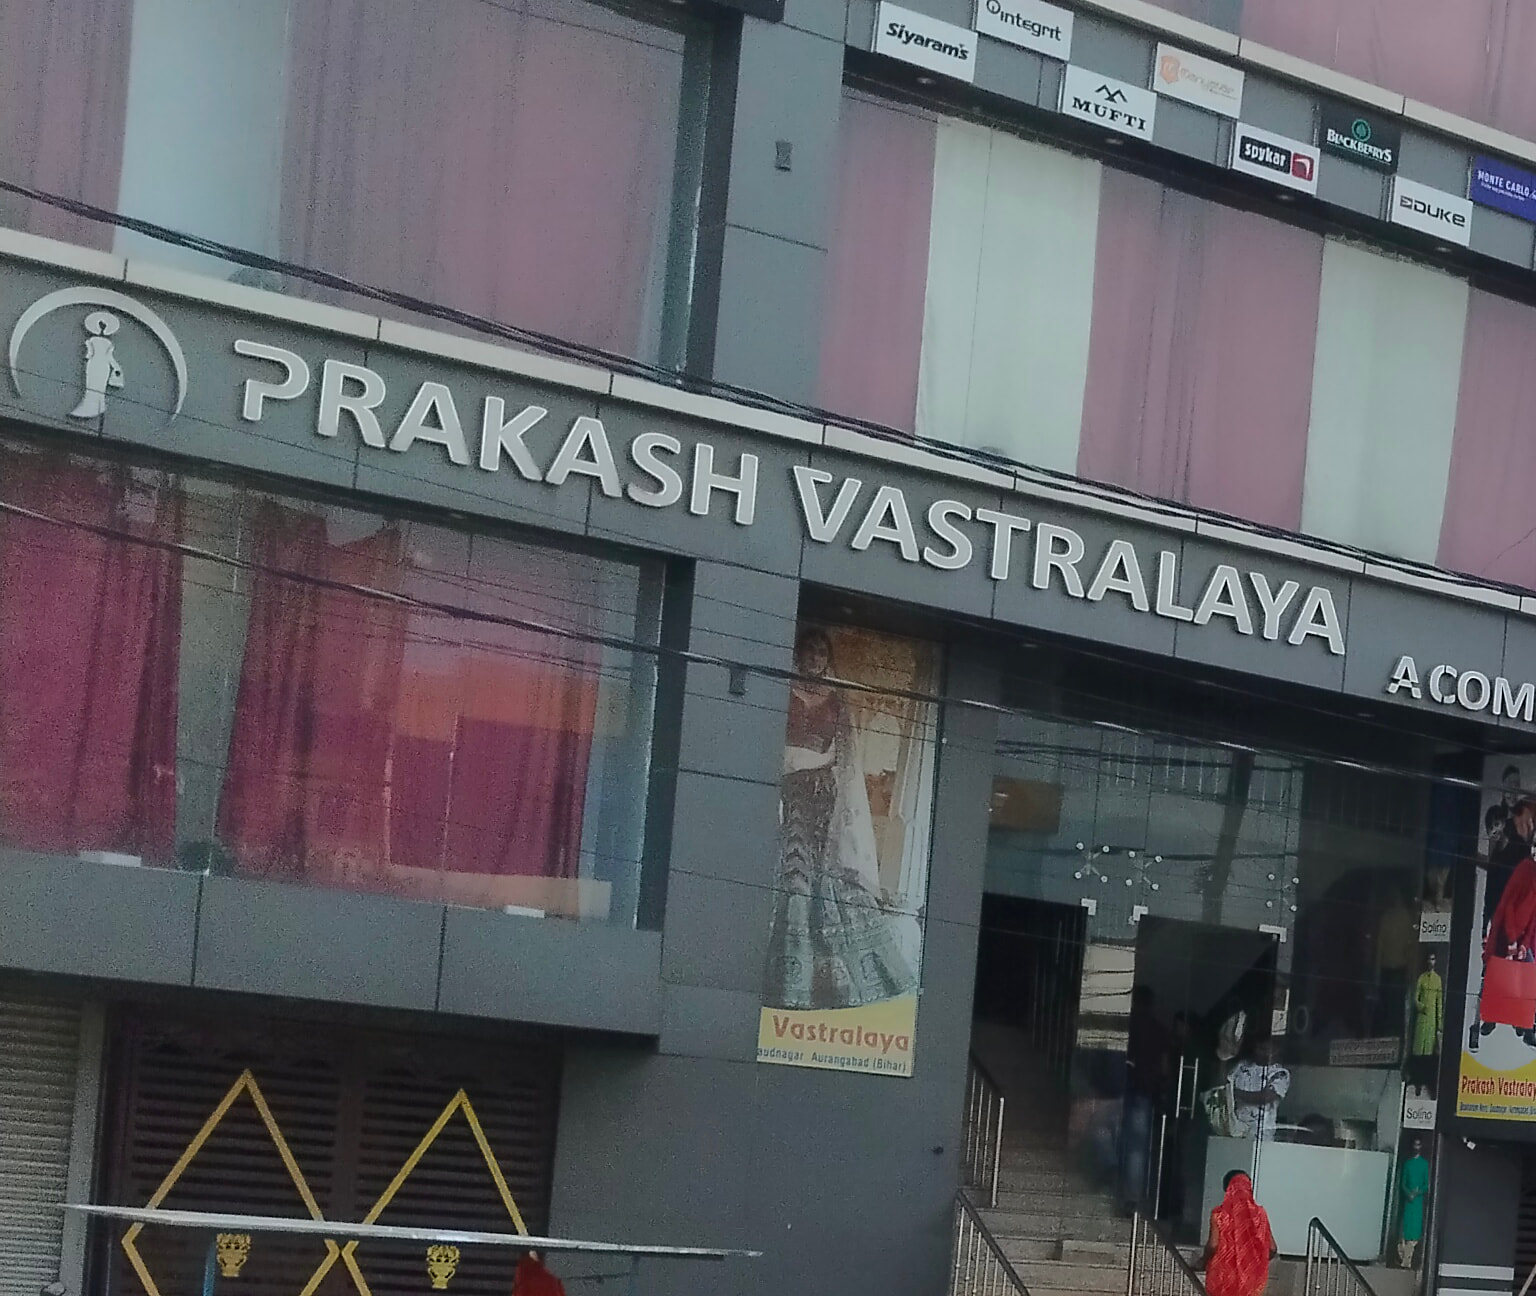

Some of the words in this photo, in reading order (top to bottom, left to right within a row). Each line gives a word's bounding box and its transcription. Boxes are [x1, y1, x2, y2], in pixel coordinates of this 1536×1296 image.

[886, 22, 969, 60] Siyaram's
[1072, 96, 1146, 131] MUFTI
[1244, 142, 1286, 167] spykar
[1477, 169, 1504, 188] MONTE
[1505, 179, 1529, 198] CARLO
[1413, 196, 1466, 227] DUKE
[233, 339, 758, 525] PRAKASH
[793, 465, 1345, 655] VASTRALAYA
[1386, 655, 1422, 699] A
[773, 1015, 909, 1054] Vastralaya
[758, 1047, 803, 1062] audnagar
[811, 1052, 869, 1067] Aurangabad
[1461, 1075, 1495, 1095] Prakash
